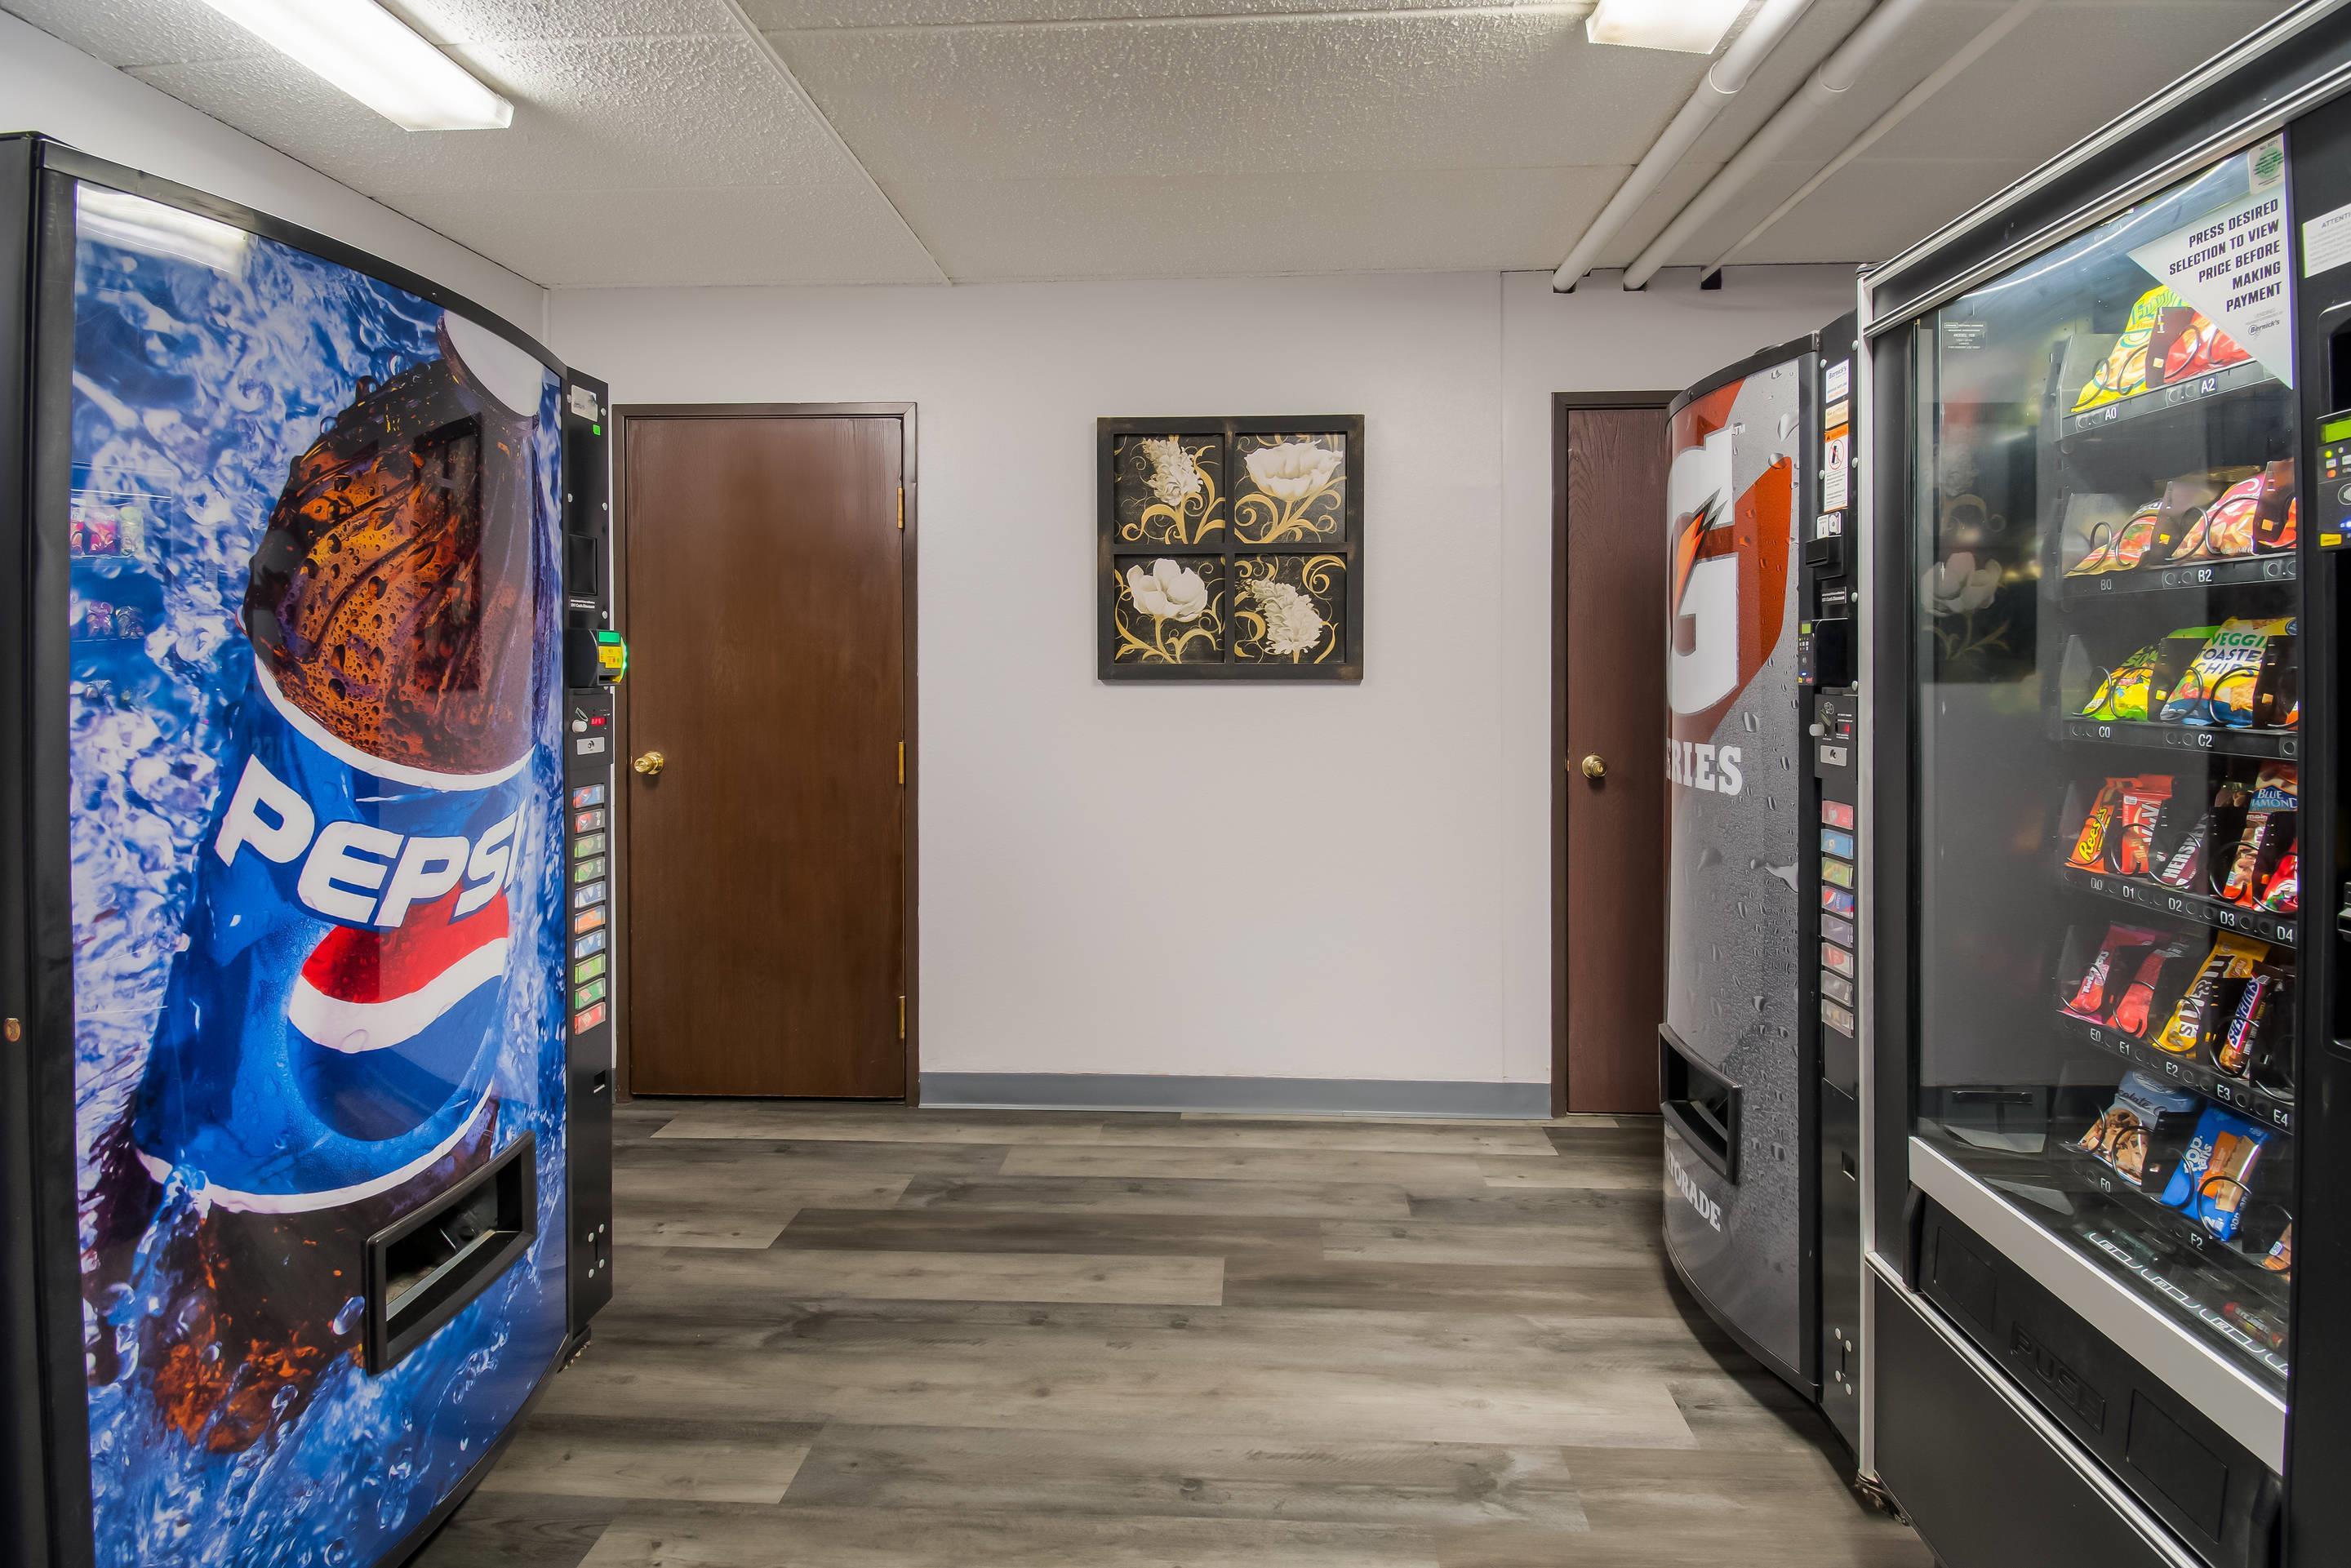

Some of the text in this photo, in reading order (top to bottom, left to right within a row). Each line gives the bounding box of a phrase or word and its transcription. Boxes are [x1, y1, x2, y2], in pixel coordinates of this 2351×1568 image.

[2189, 198, 2279, 248] PRESS DESIRED
[2321, 211, 2351, 229] ATTENTI
[2169, 219, 2280, 276] SELECTION TO VIEW
[2198, 259, 2232, 283] PRICE
[2235, 239, 2281, 269] BEFORE
[2232, 260, 2282, 291] MAKING
[2226, 281, 2282, 313] PAYMENT
[2201, 378, 2215, 393] A2
[2104, 408, 2118, 421] A0
[2198, 569, 2212, 583] B2
[2100, 578, 2113, 591] B0
[2099, 726, 2110, 739] C0
[2198, 735, 2213, 748] C2
[2257, 788, 2284, 799] BLUE
[2251, 797, 2299, 809] IAMOND
[215, 754, 527, 928] PEPSI
[2091, 878, 2103, 891] D0
[2122, 886, 2135, 899] D1
[2168, 899, 2183, 913] D2
[2220, 911, 2235, 926] D3
[2278, 926, 2294, 942] D4
[2229, 979, 2258, 1047] SNICKERS
[2091, 1032, 2101, 1045] E0
[2120, 1042, 2130, 1054] E1
[2166, 1061, 2179, 1078] E2
[2216, 1086, 2231, 1102] E3
[2273, 1110, 2288, 1127] E4
[1665, 1144, 1721, 1233] TORADE
[2100, 1178, 2112, 1193] F0
[2190, 1233, 2203, 1250] F2
